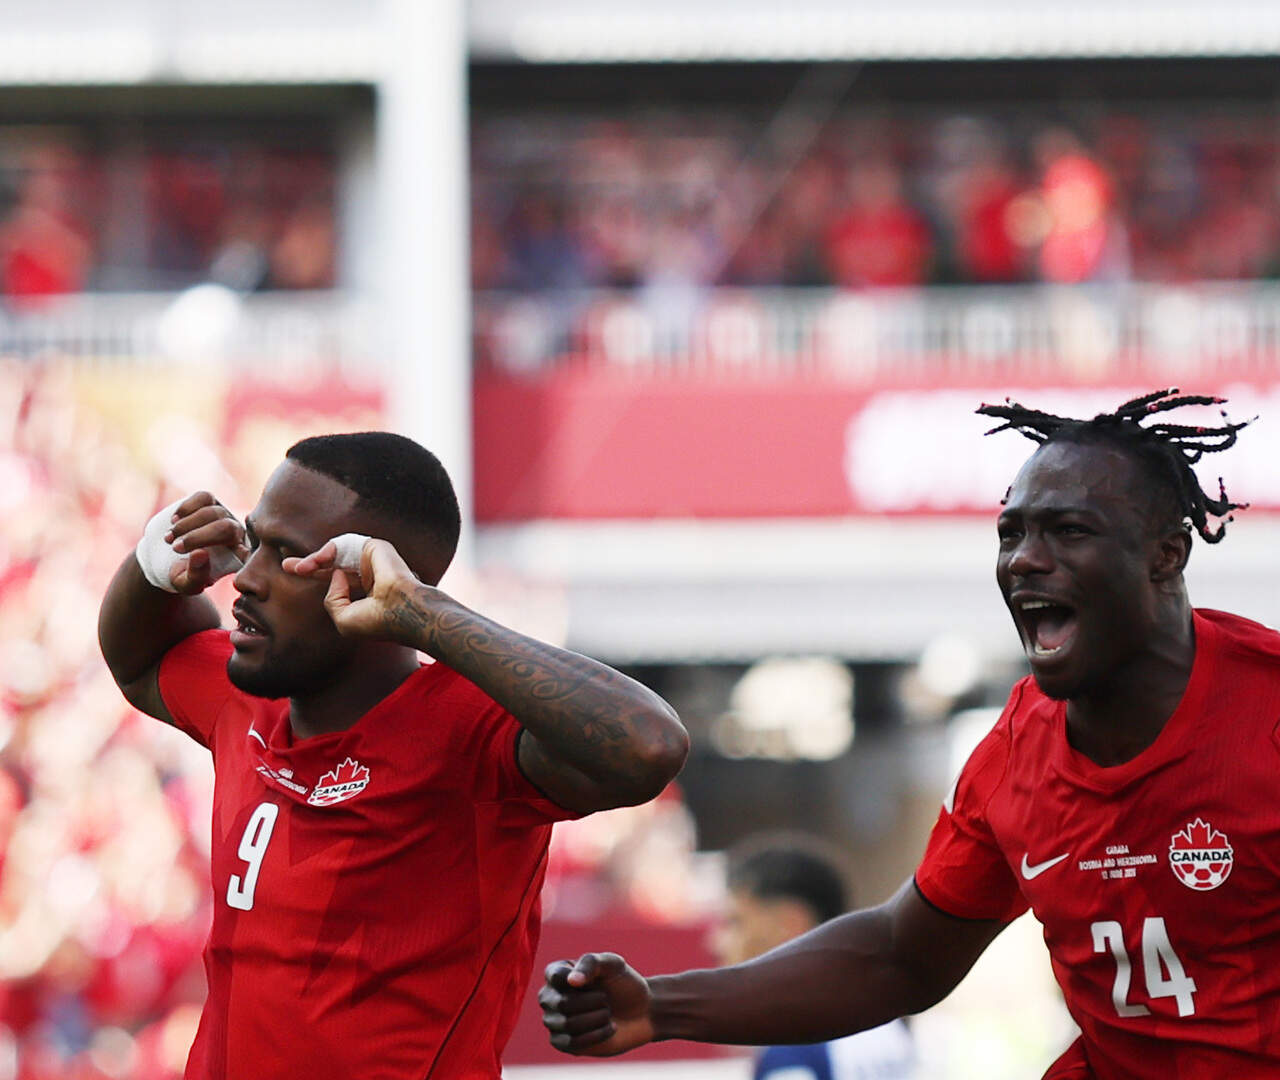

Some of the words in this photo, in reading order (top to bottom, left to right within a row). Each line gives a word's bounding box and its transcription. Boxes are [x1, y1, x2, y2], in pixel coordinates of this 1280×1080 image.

[313, 781, 364, 796] CANADA
[226, 802, 279, 911] 9
[1171, 851, 1230, 862] CANADA
[1091, 917, 1197, 1017] 24
